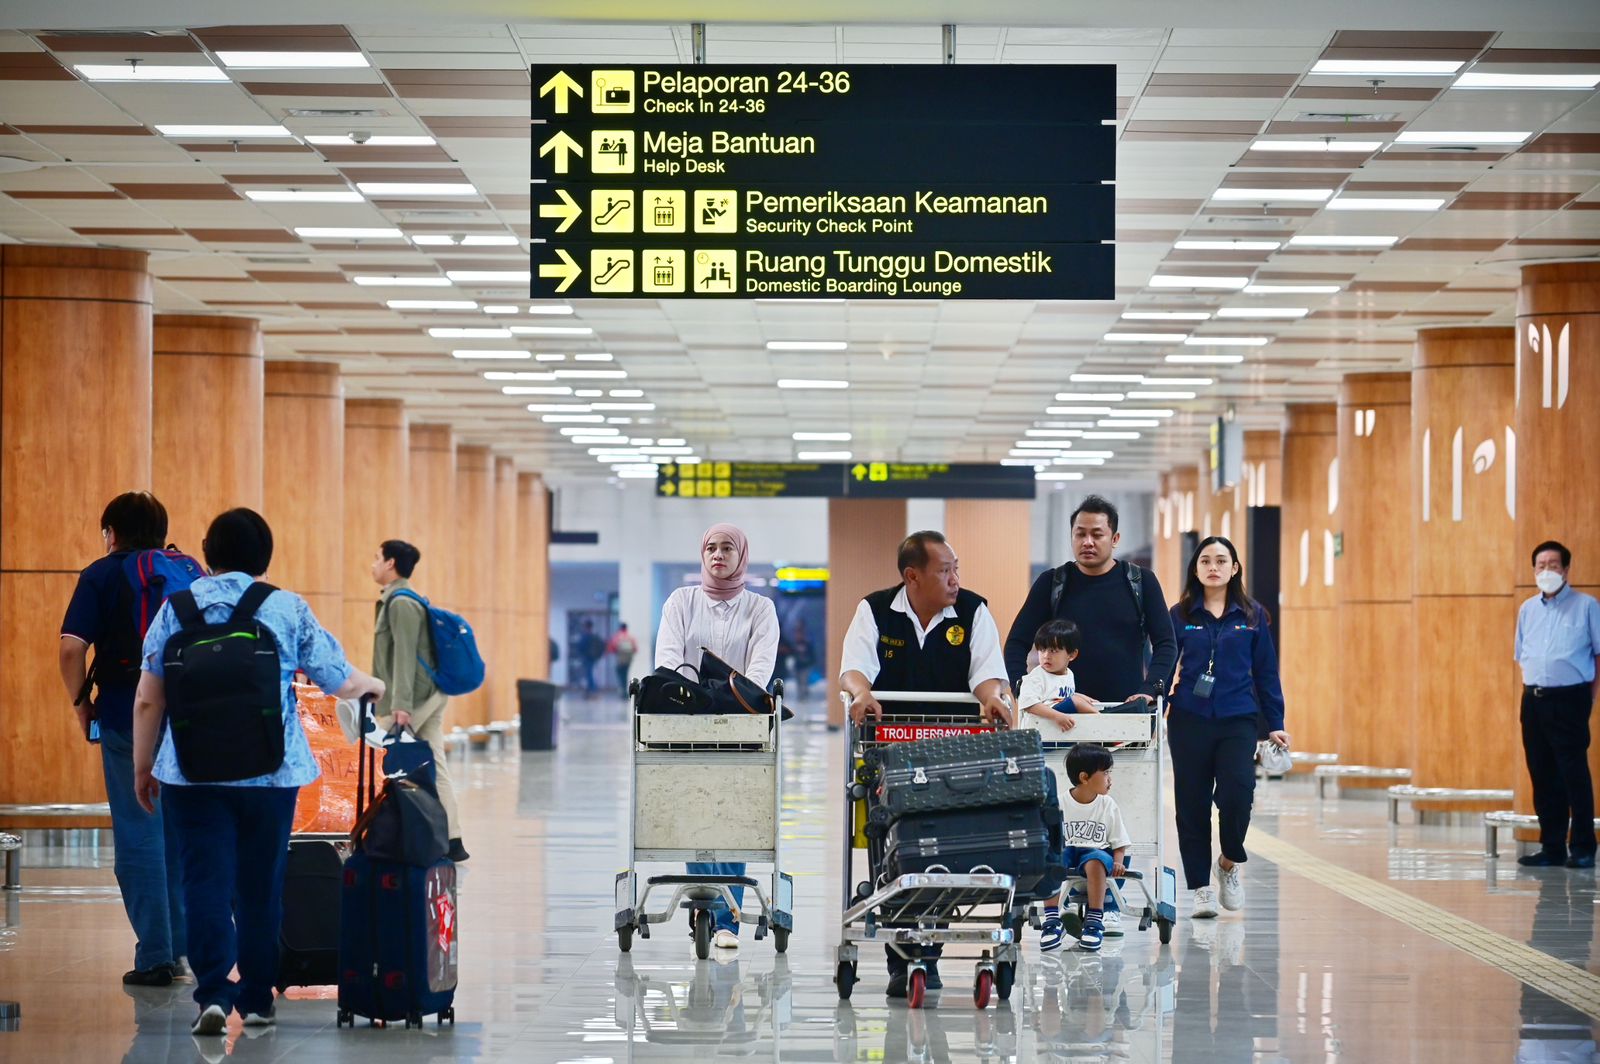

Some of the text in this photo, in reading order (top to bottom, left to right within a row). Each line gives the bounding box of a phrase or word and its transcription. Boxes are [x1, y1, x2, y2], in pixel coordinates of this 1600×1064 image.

[643, 71, 851, 98] Pelaporan 24-36
[643, 99, 766, 113] Check In 24-36
[643, 131, 815, 158] Meja Bantuan
[643, 159, 726, 176] Help Desk
[746, 191, 1048, 214] Pemeriksaan Keamanan
[745, 218, 914, 236] Security Check Point
[745, 250, 1052, 279] Ruang Tunggu Domestik
[746, 279, 962, 296] Domestic Boarding Lounge
[883, 728, 913, 739] TROLI
